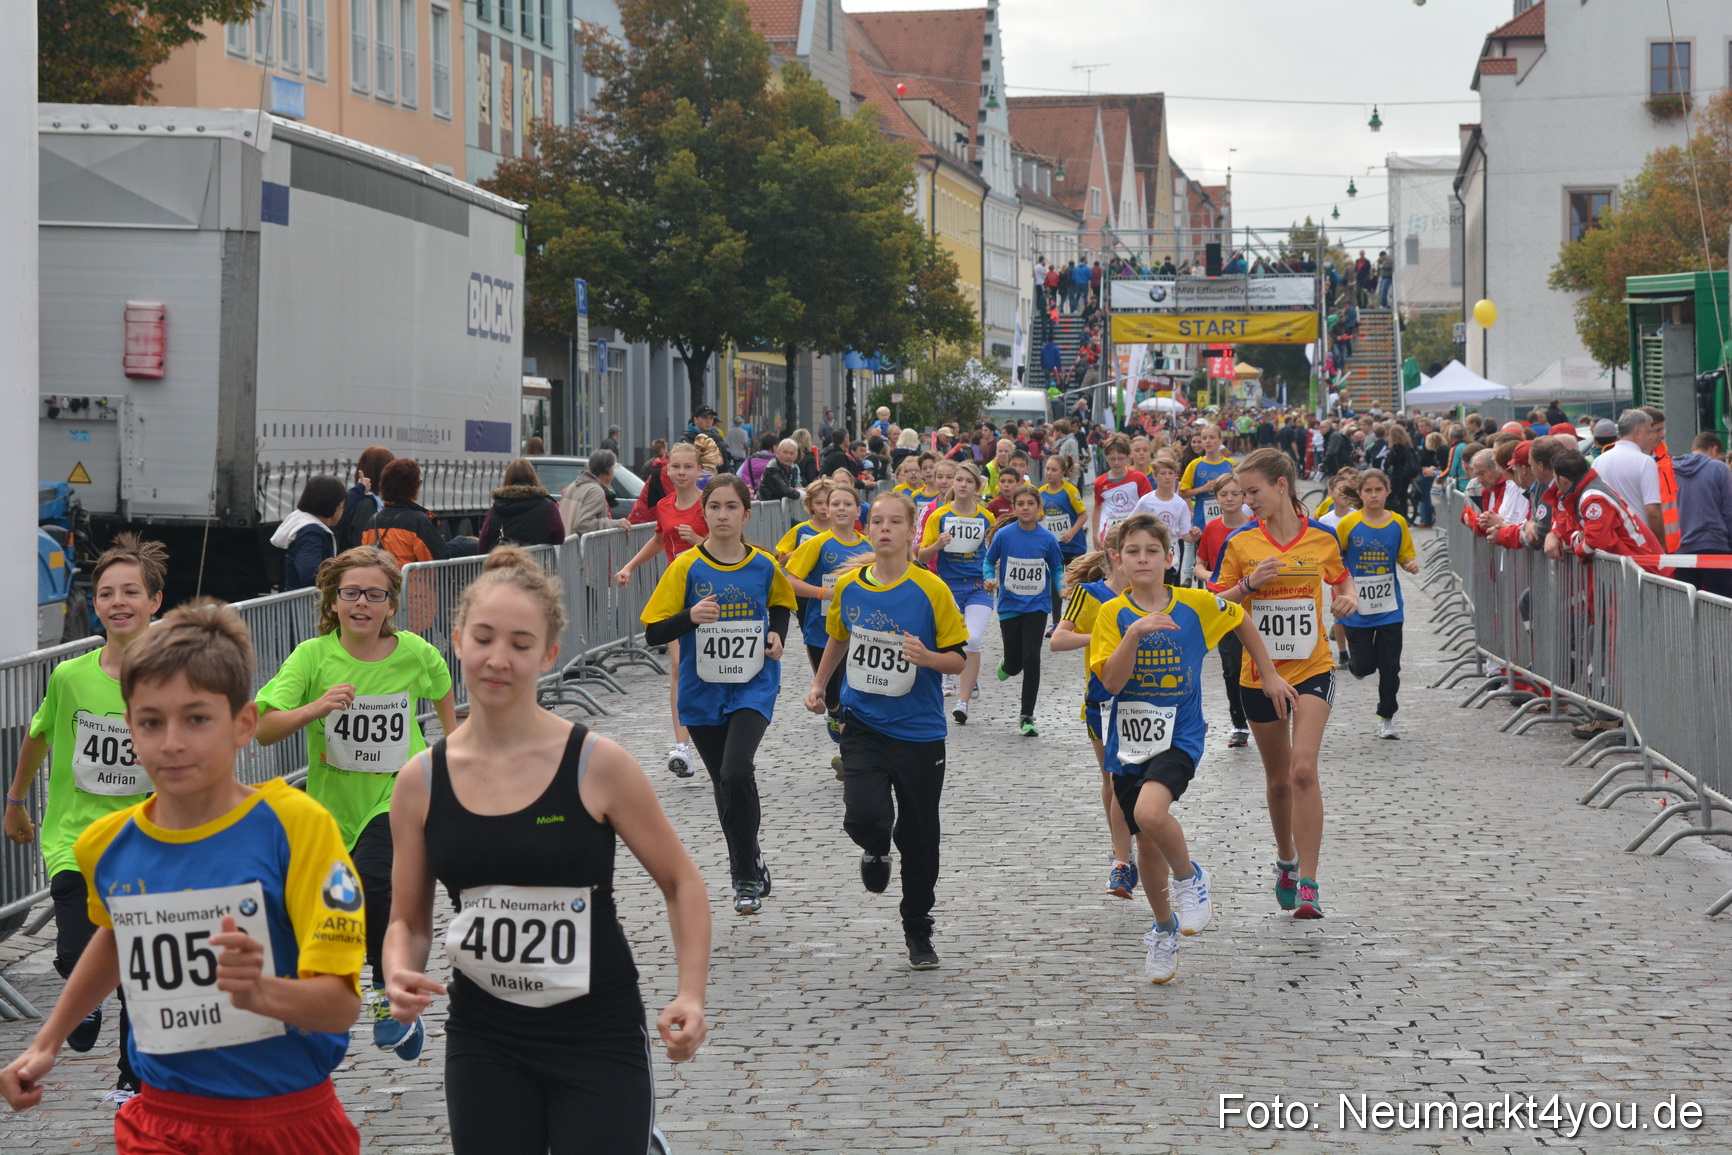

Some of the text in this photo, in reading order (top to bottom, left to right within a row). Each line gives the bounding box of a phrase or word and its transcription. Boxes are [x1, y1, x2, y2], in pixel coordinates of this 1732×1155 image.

[467, 271, 514, 343] BOCK
[1179, 319, 1250, 336] START
[948, 525, 981, 540] 4102
[1047, 521, 1069, 532] 4104
[1009, 567, 1042, 582] 4048
[1012, 583, 1038, 591] Valentina
[1358, 582, 1392, 600] 4022
[721, 626, 753, 634] Neumarkt
[1258, 614, 1312, 636] 4015
[852, 631, 904, 647] PARTL Neumark
[703, 636, 758, 659] 4027
[1275, 642, 1295, 653] Lucy
[852, 643, 910, 674] 4035
[718, 665, 743, 674] Linda
[866, 674, 889, 687] Elisa
[358, 702, 399, 711] Neumarkt
[1130, 707, 1162, 716] Neumarkt
[79, 719, 106, 732] PARTL
[333, 712, 405, 743] 4039
[1121, 717, 1167, 742] 4023
[83, 734, 138, 767] 403
[355, 750, 381, 762] Paul
[97, 771, 136, 785] Adrian
[536, 814, 566, 825] Maike
[500, 898, 566, 912] Neumarkt
[113, 904, 232, 927] PARTL Neumarkt
[459, 916, 577, 966] 4020
[129, 925, 249, 992] 405
[490, 972, 545, 992] Maike
[159, 1001, 223, 1030] David
